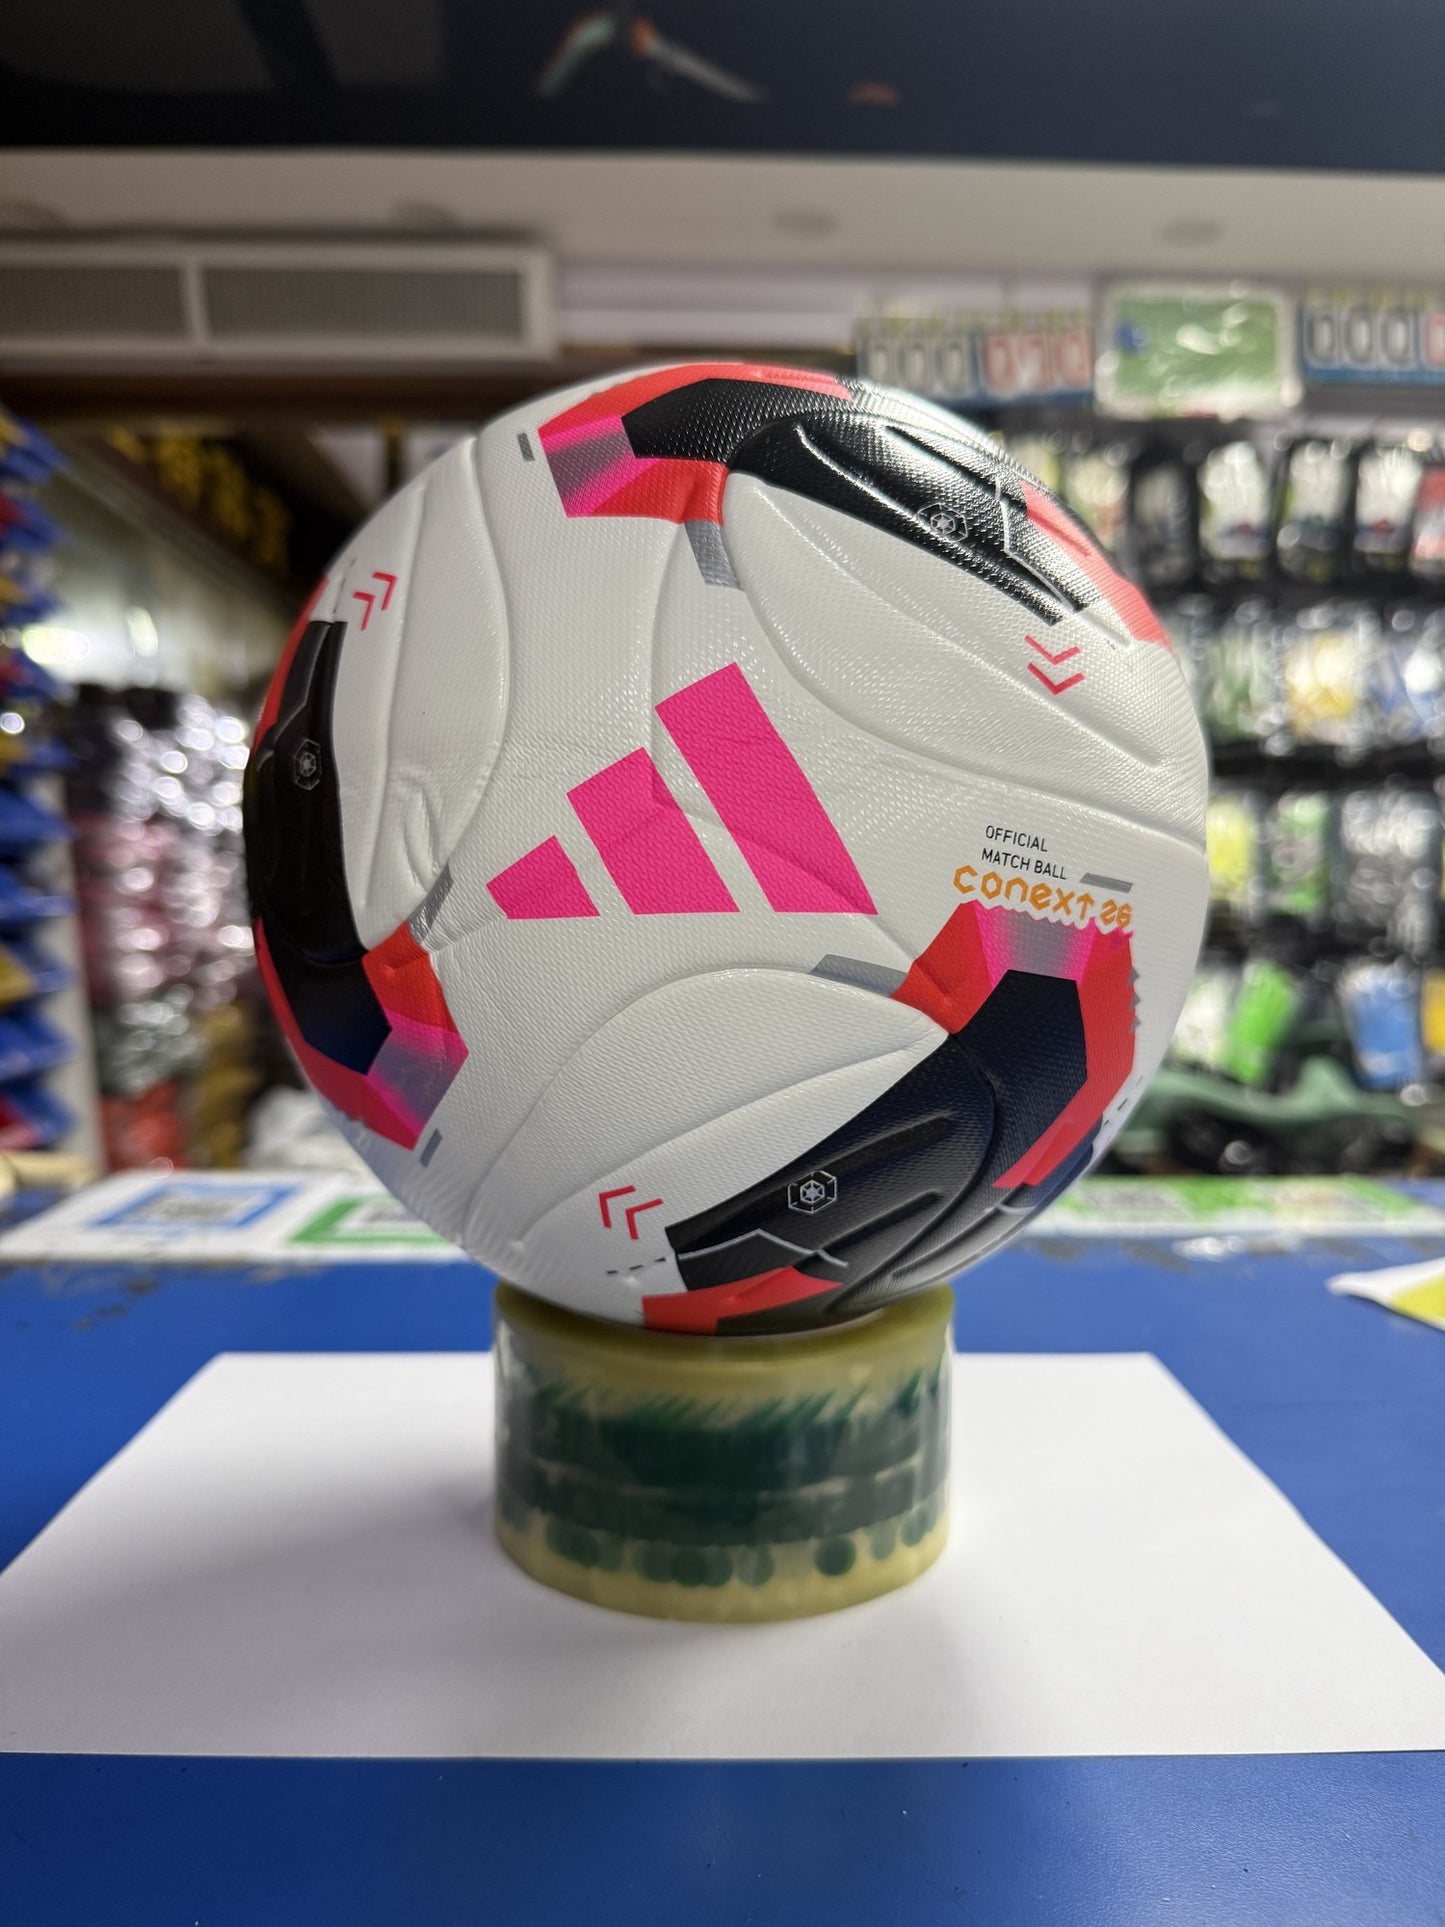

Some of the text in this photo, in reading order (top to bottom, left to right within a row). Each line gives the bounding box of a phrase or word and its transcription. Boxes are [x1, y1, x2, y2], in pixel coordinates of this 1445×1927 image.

[985, 825, 1048, 852] OFFICIAL
[981, 848, 1067, 880] MATCH BALL
[1099, 899, 1132, 928] 26
